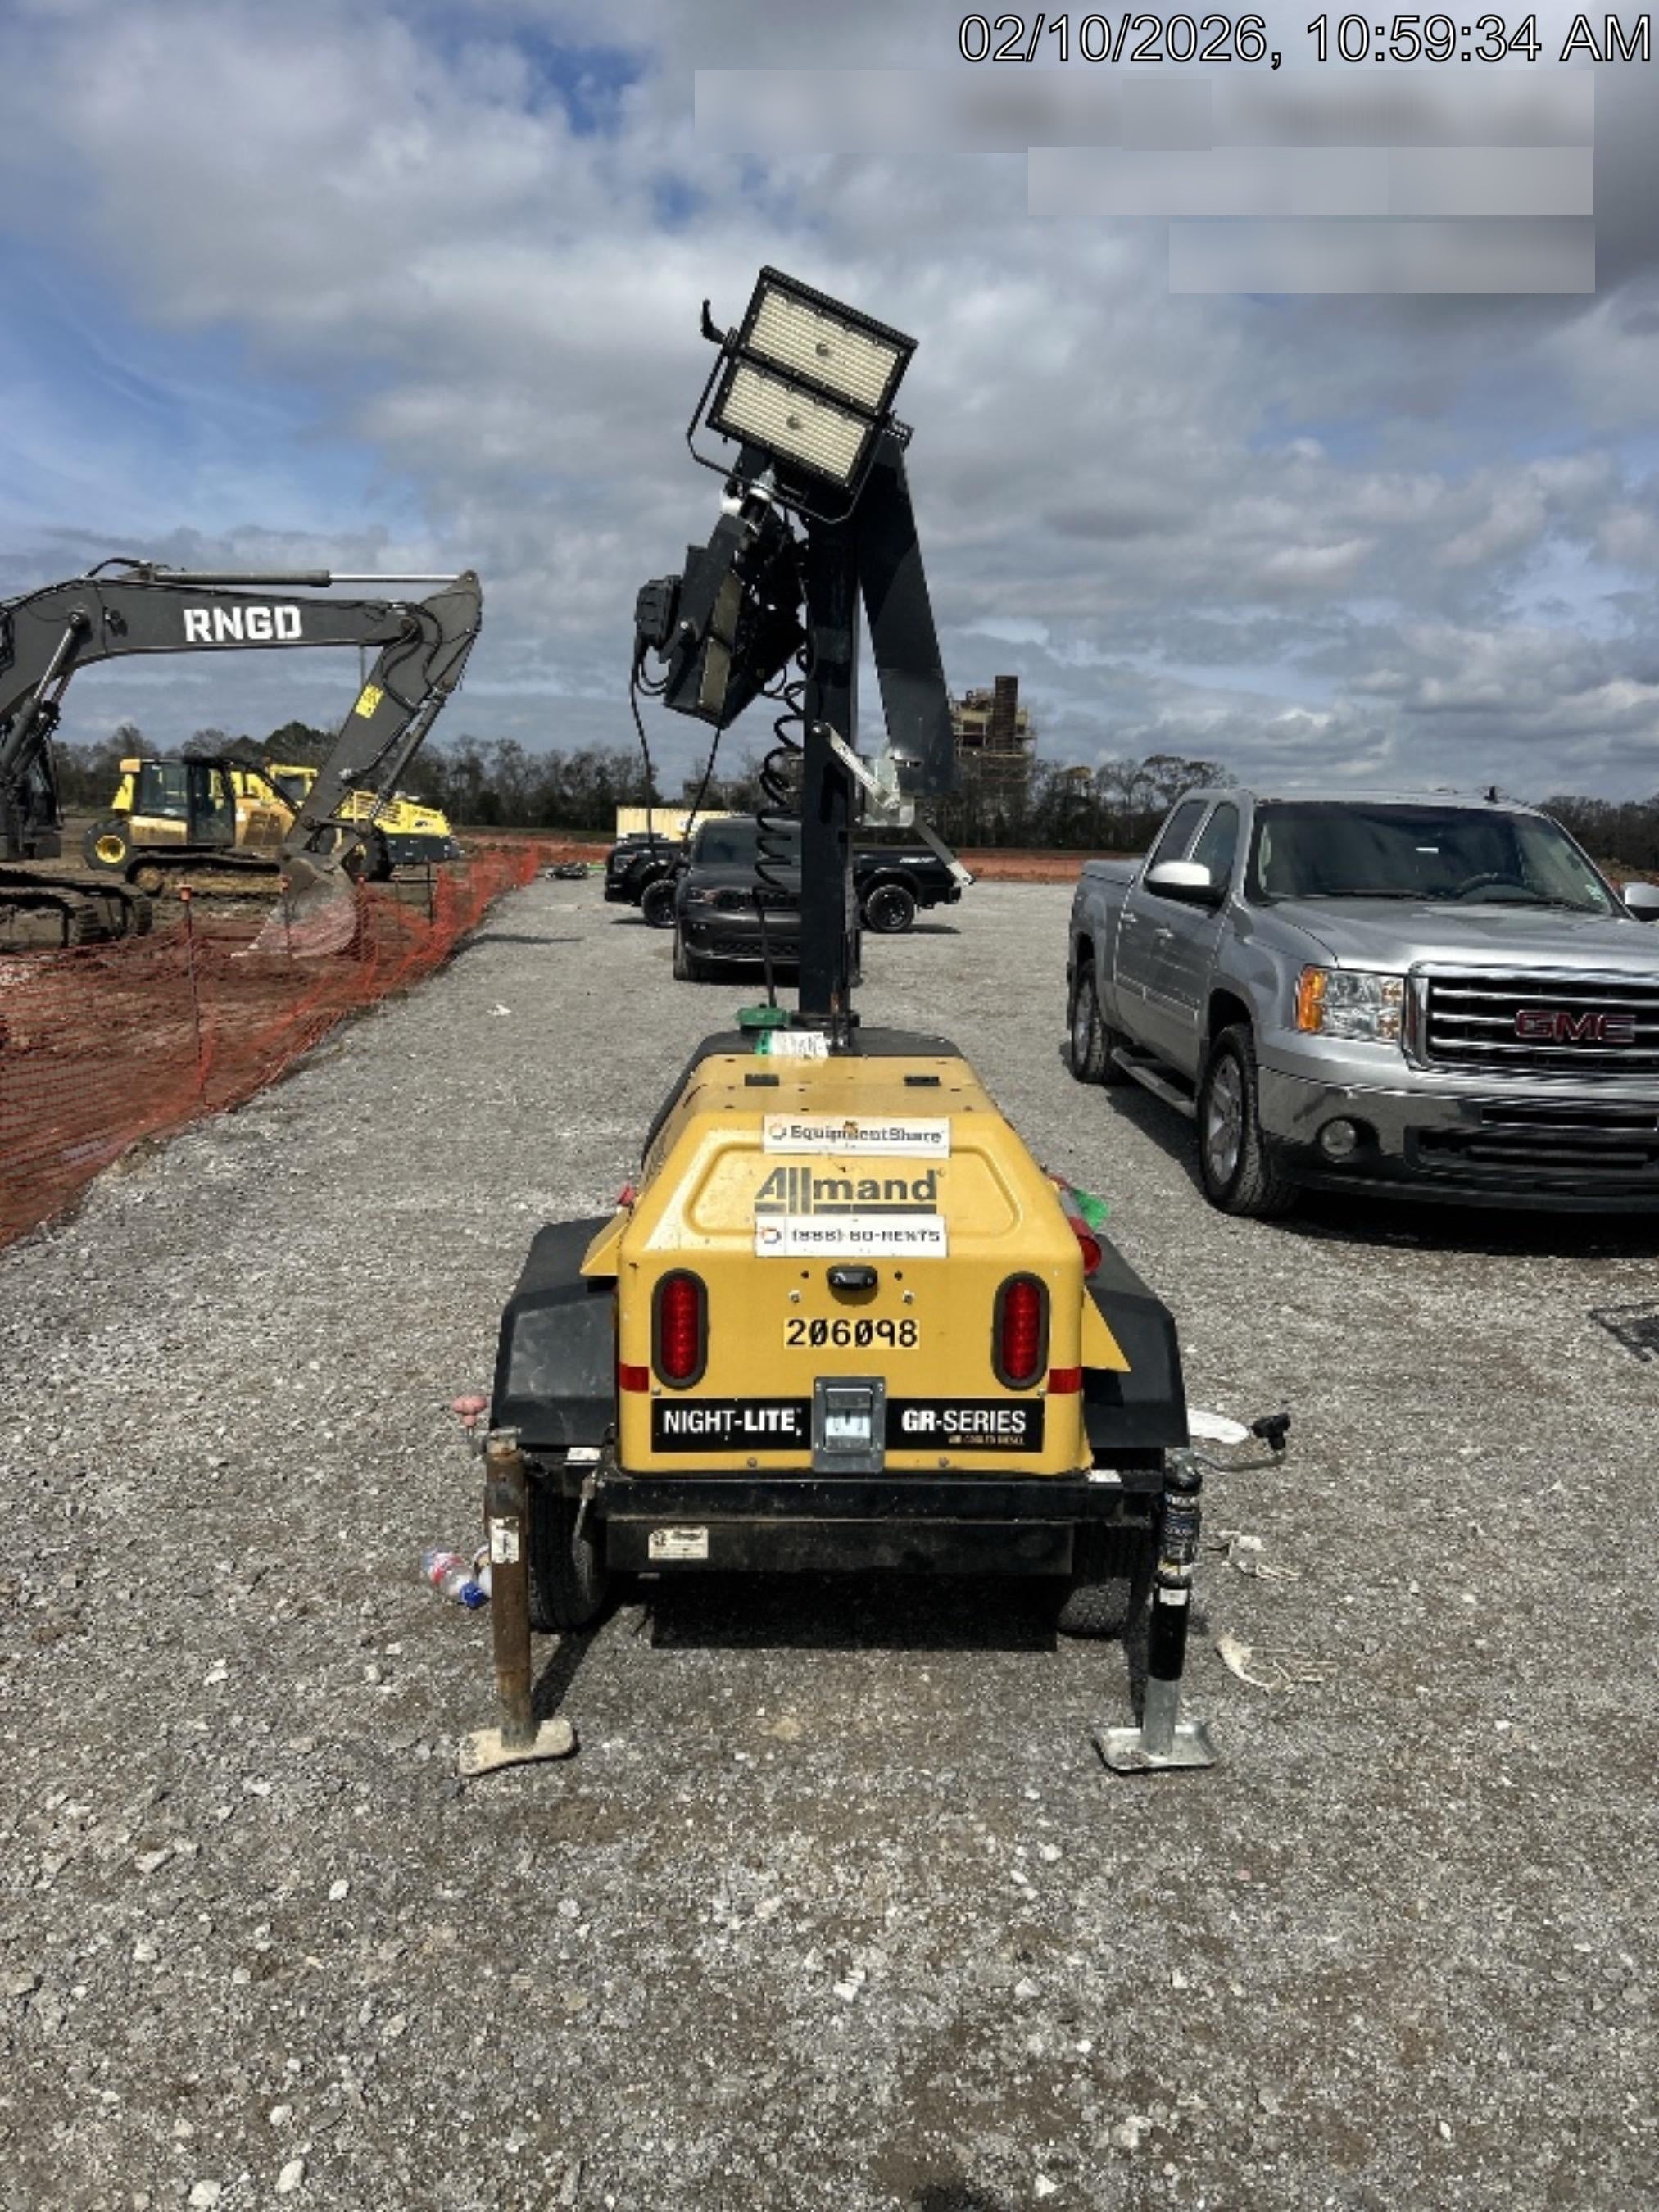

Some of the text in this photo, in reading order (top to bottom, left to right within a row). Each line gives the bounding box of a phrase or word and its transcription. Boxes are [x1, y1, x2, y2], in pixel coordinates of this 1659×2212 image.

[183, 605, 302, 642] RNGD
[754, 1167, 937, 1215] Allmand
[786, 1319, 918, 1347] 206098
[664, 1408, 796, 1435] NIGHT-LITE
[902, 1410, 1027, 1434] GR-SERIES
